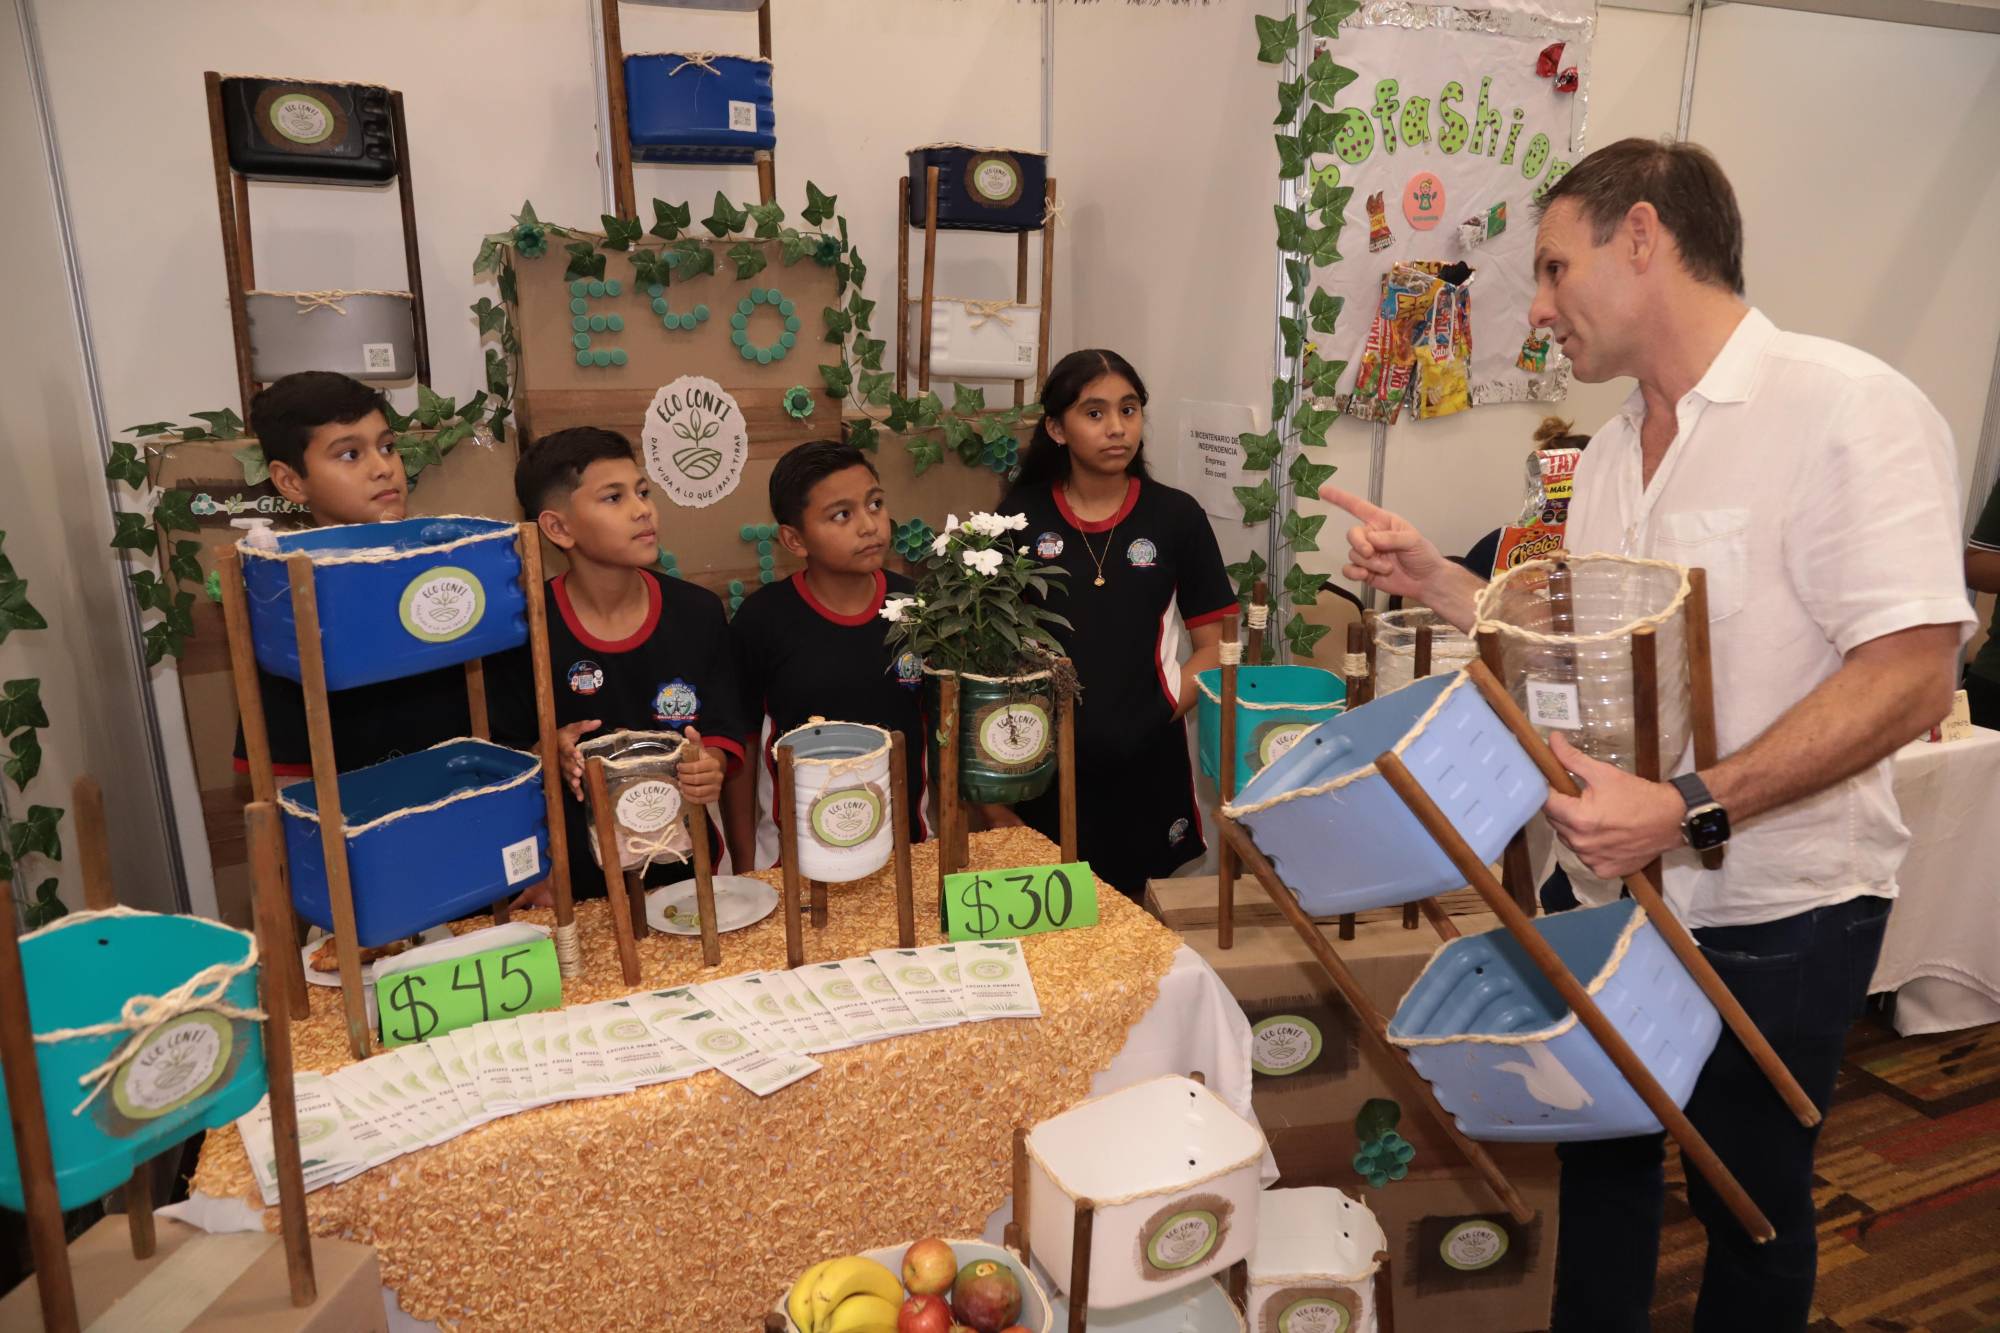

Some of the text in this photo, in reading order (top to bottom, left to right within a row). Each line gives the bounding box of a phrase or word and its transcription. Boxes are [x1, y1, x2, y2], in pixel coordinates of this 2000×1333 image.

[656, 388, 732, 423] ECO CONTI
[651, 437, 660, 463] DALE
[657, 466, 673, 487] VIDA
[684, 490, 694, 498] LO
[697, 489, 713, 501] QUE
[715, 476, 731, 493] IBAS
[733, 435, 741, 463] TIRAR
[1508, 534, 1561, 569] Cheetos
[422, 582, 468, 598] ECO CONTI
[961, 869, 1073, 939] $30
[390, 949, 533, 1042] $45
[141, 1030, 207, 1067] ECO CONTI
